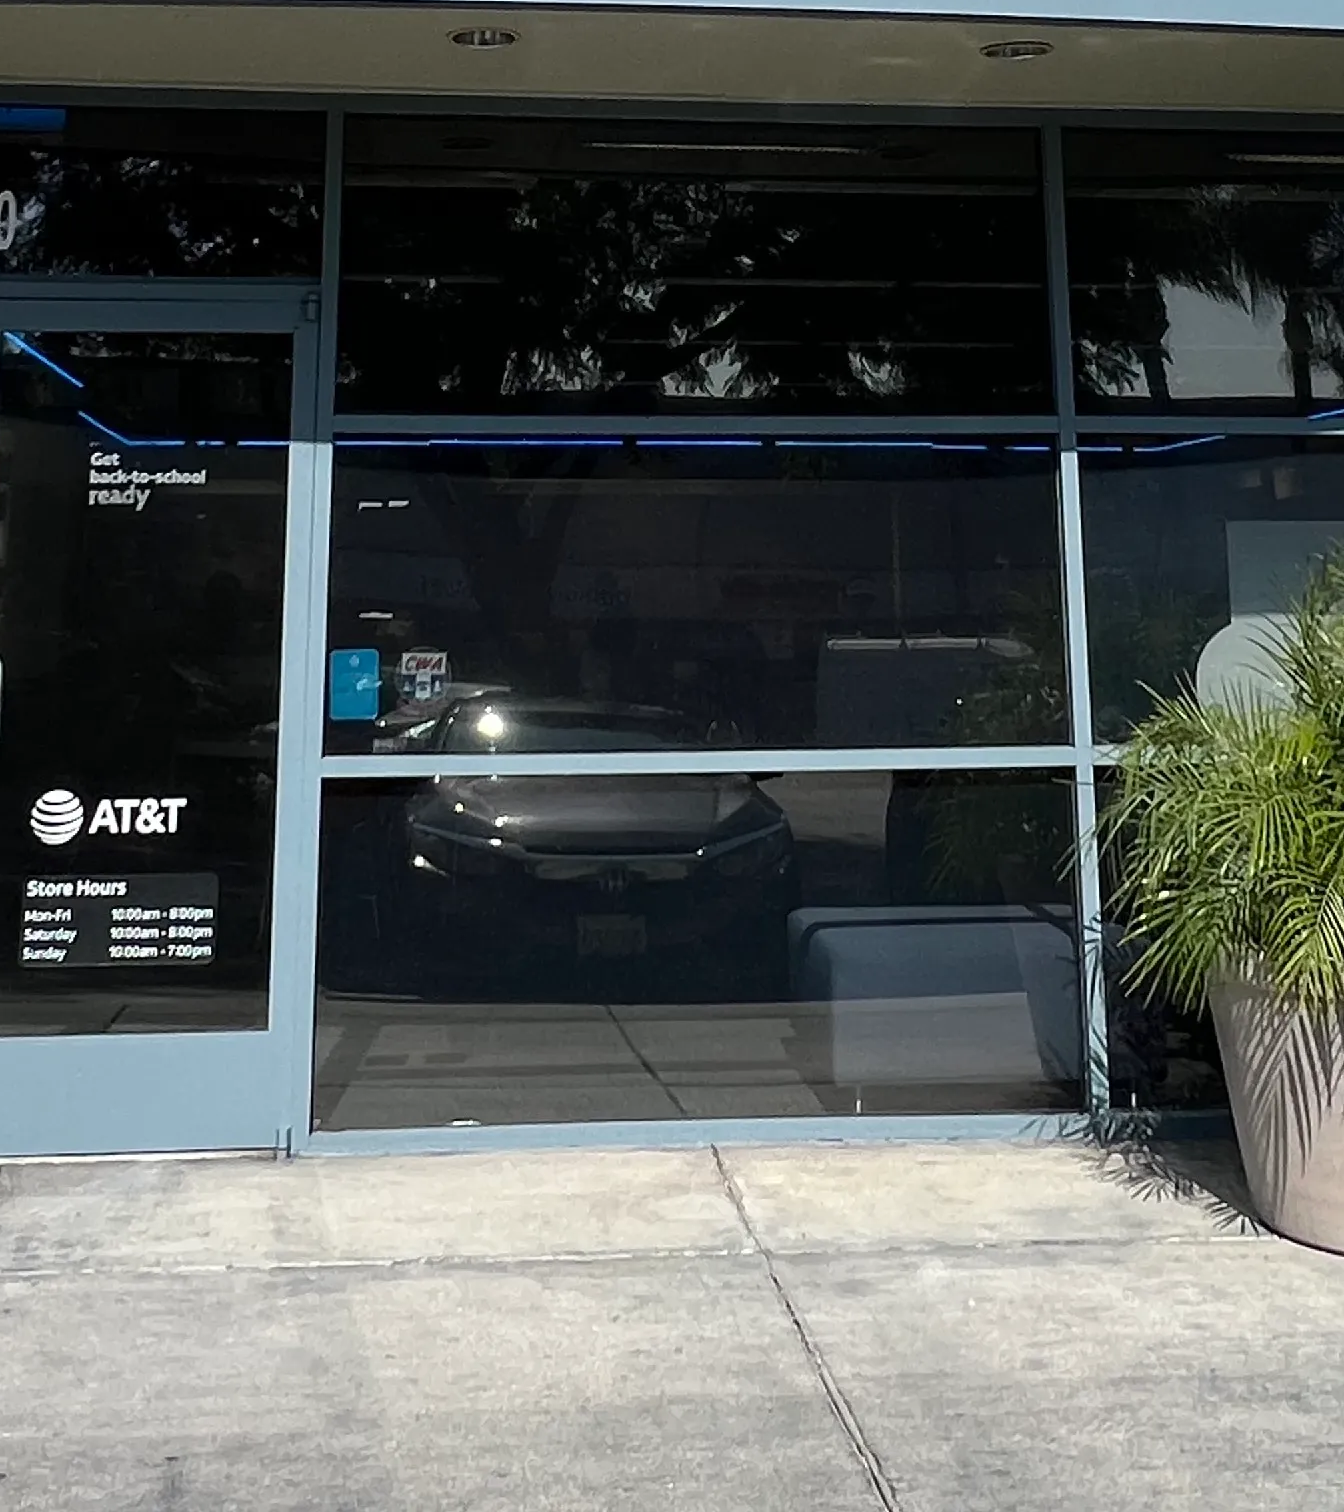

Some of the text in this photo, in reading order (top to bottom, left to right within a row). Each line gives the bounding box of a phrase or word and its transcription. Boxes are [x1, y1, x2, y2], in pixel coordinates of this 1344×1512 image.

[90, 452, 121, 466] Get
[89, 468, 206, 484] back-to-school
[88, 484, 151, 511] ready
[405, 654, 444, 672] CWA
[88, 797, 188, 834] AT&T
[26, 879, 128, 897] Store Hours
[24, 908, 71, 922] Mon-Fri
[23, 927, 77, 943] Saturday
[22, 946, 67, 961] Sunday
